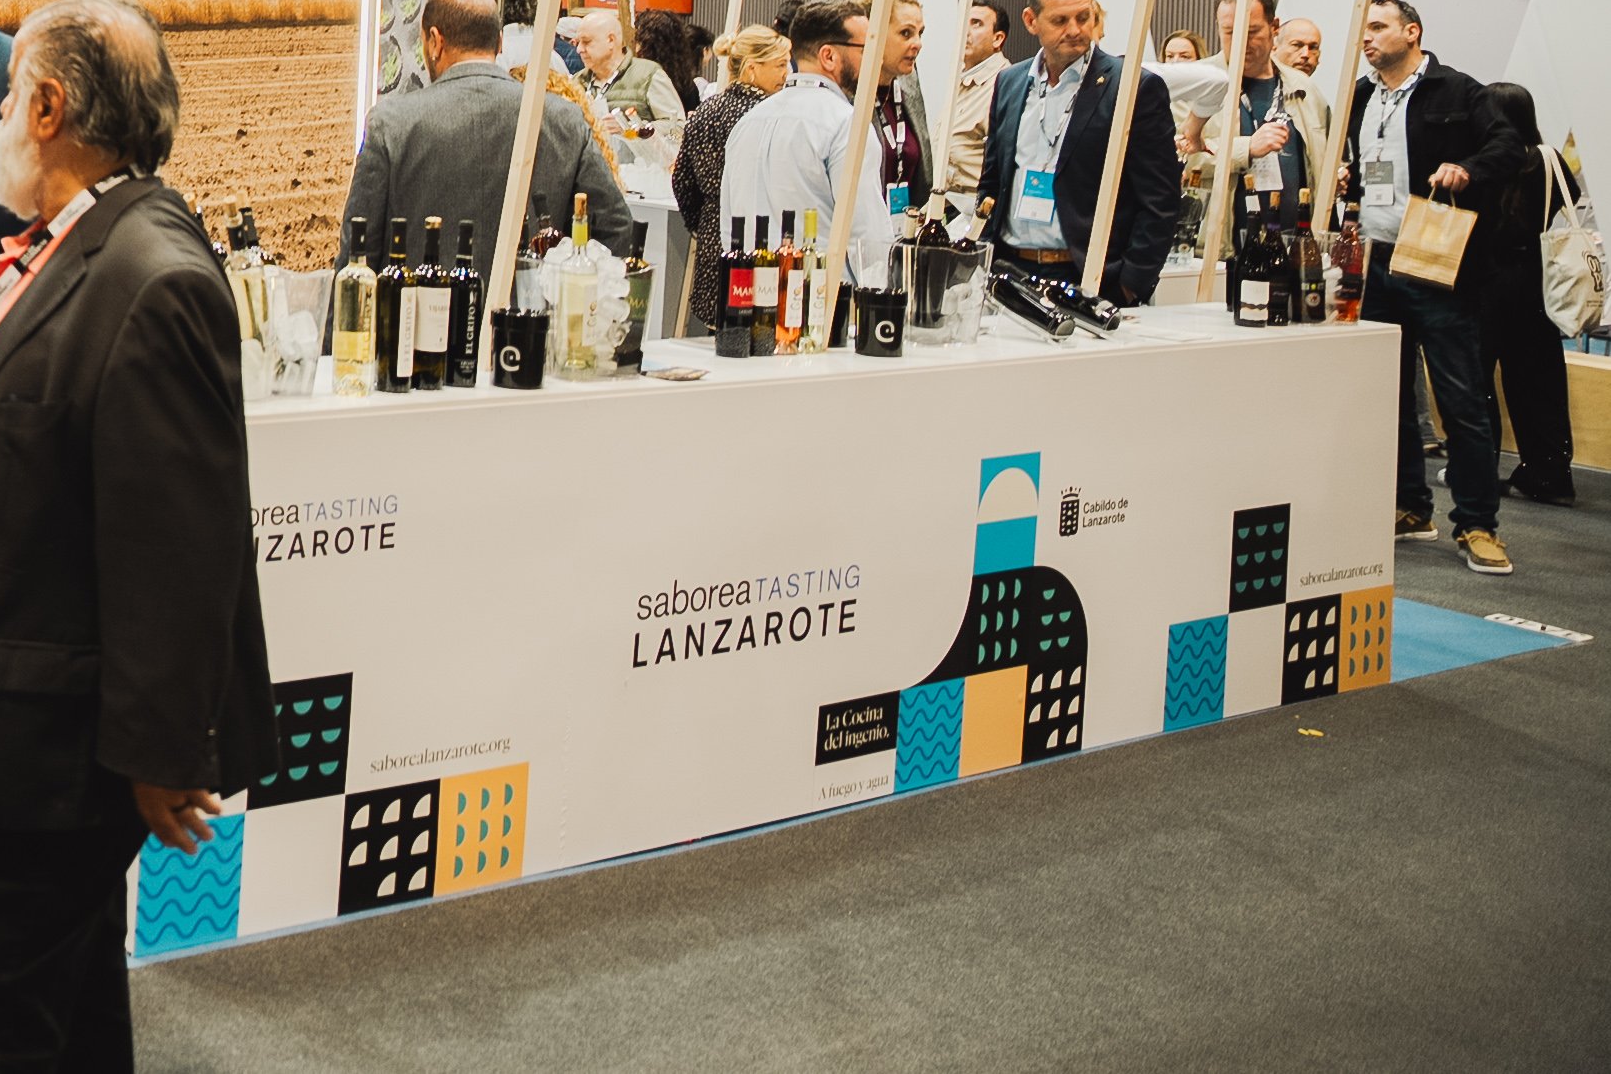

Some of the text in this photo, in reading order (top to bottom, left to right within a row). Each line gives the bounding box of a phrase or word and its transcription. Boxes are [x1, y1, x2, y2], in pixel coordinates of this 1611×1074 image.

[466, 305, 476, 340] GRIFO
[465, 338, 474, 355] EL
[1083, 496, 1129, 514] Cabildo de
[1082, 512, 1126, 528] Lanzarote
[254, 521, 397, 566] ZAROTE
[632, 598, 857, 668] LANZAROTE
[826, 706, 884, 731] La Cocina
[824, 724, 890, 751] del ingenio.
[369, 736, 511, 775] saborealanzarote.org
[828, 782, 857, 800] fuego
[866, 774, 889, 790] agua
